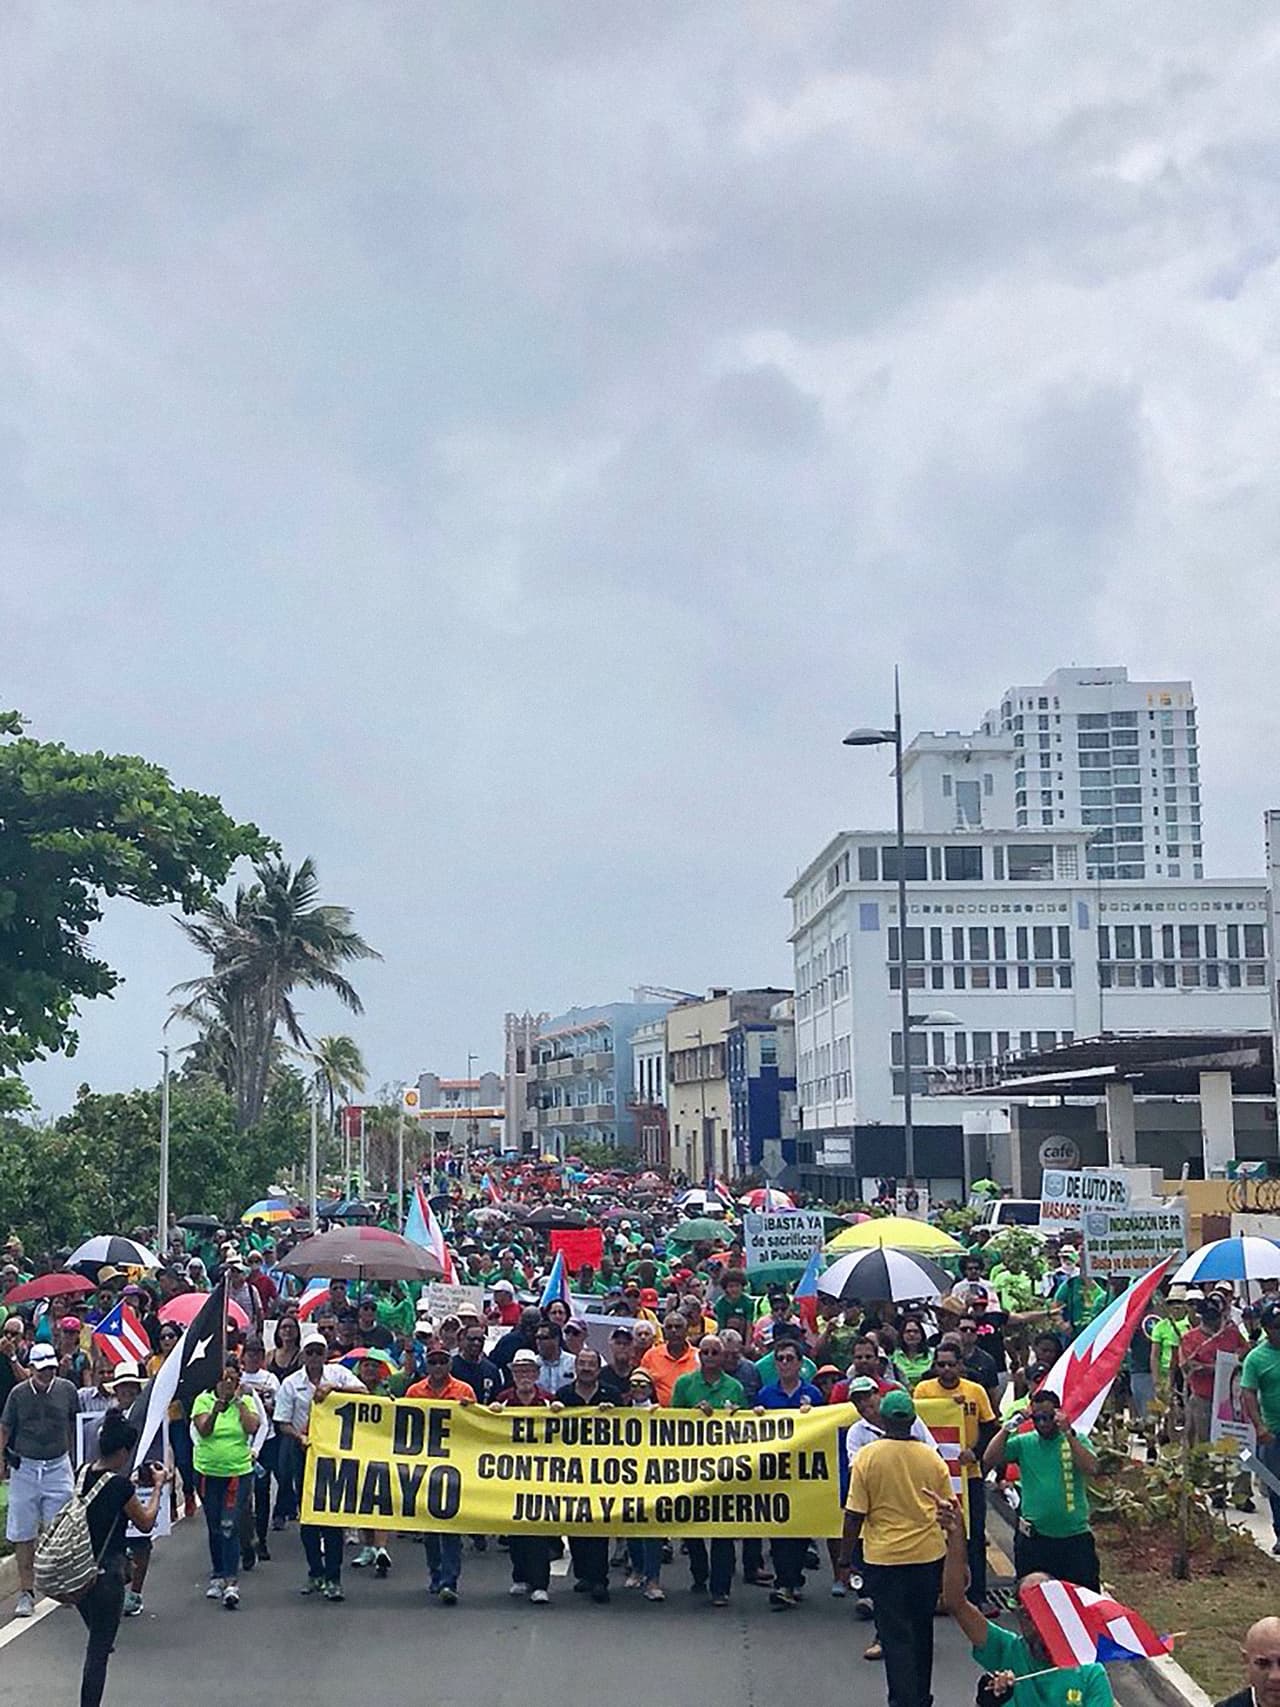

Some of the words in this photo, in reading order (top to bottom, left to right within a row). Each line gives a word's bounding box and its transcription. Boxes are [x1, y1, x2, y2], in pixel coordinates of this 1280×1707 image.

[1044, 1142, 1073, 1158] café
[1066, 1177, 1081, 1198] DE
[1082, 1178, 1108, 1201] LUTO
[1041, 1201, 1081, 1221] MASACRE
[807, 1216, 822, 1229] YA
[1158, 1215, 1170, 1230] DE
[751, 1235, 765, 1247] de
[768, 1233, 819, 1247] sacrificar
[760, 1250, 769, 1262] al
[393, 1405, 451, 1458] DE
[512, 1417, 538, 1443] EL
[545, 1417, 642, 1446] PUEBLO
[650, 1417, 794, 1446] INDIGNADO
[478, 1453, 584, 1484] CONTRA
[590, 1458, 638, 1484] LOS
[645, 1454, 753, 1485] ABUSOS
[759, 1452, 791, 1480] DE
[798, 1451, 829, 1480] LA
[313, 1457, 462, 1520] MAYO
[513, 1493, 594, 1523] JUNTA
[600, 1496, 615, 1523] Y
[622, 1497, 648, 1523] EL
[655, 1493, 790, 1524] GOBIERNO
